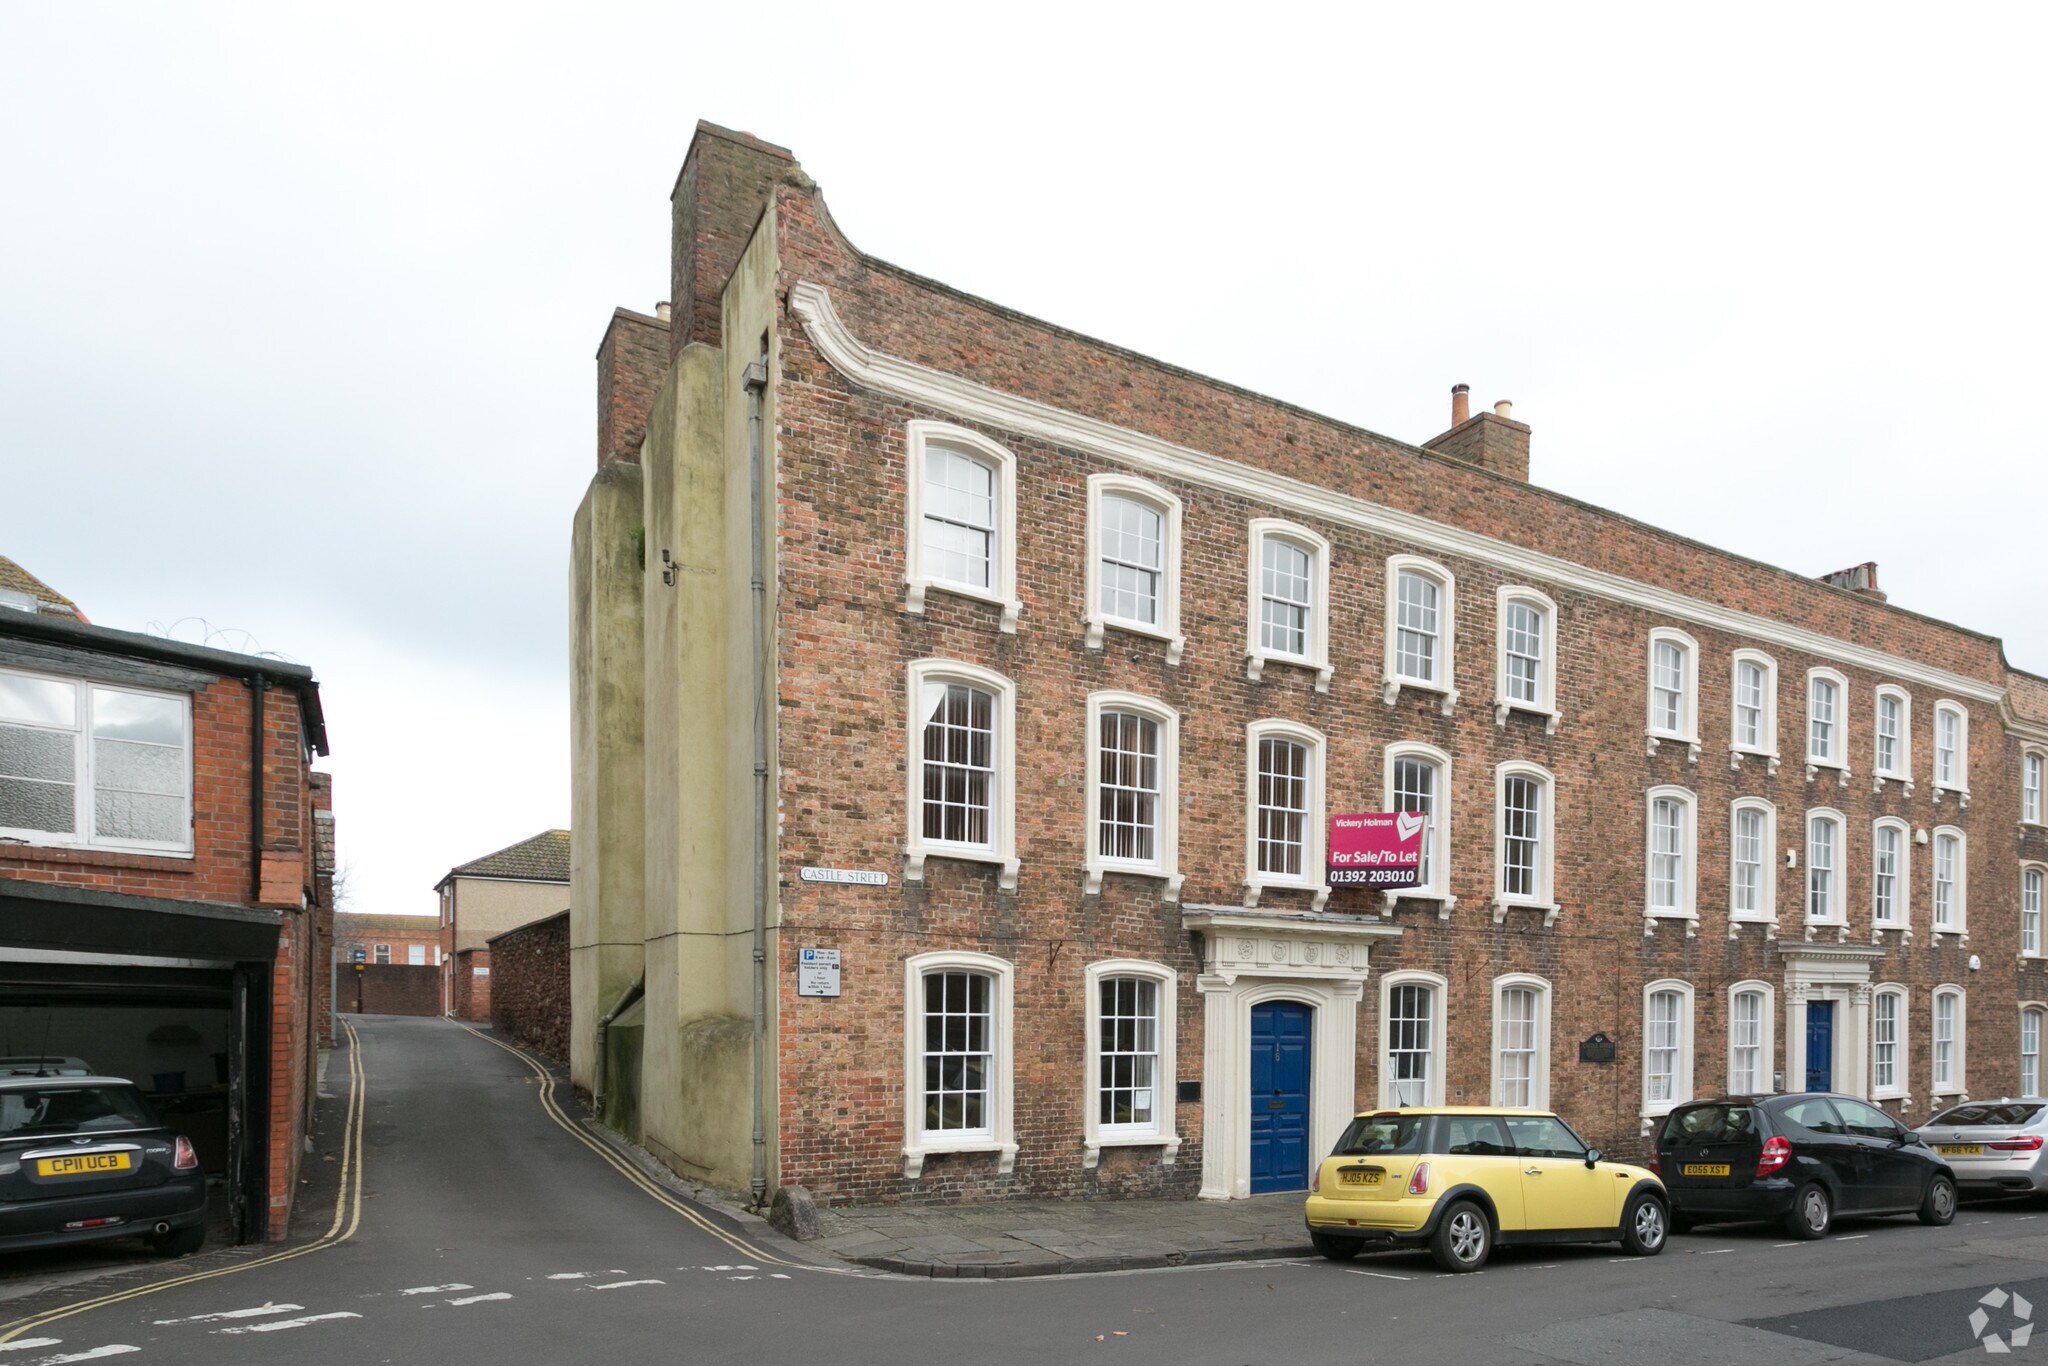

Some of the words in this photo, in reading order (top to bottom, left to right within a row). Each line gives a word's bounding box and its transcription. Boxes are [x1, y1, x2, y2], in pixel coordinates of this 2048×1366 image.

[1336, 819, 1363, 828] Vickery
[1364, 819, 1393, 827] Holman
[1333, 851, 1351, 863] For
[1354, 850, 1397, 864] Sale/To
[1400, 851, 1418, 862] Let
[803, 868, 842, 881] CASTLE
[847, 871, 886, 884] STREET
[1330, 870, 1366, 882] 01392
[1369, 870, 1414, 882] 203010
[52, 1158, 83, 1172] CP11
[88, 1155, 118, 1169] UCB
[1710, 1165, 1726, 1174] XST
[1342, 1172, 1361, 1183] HJ05
[1363, 1172, 1379, 1183] KZS
